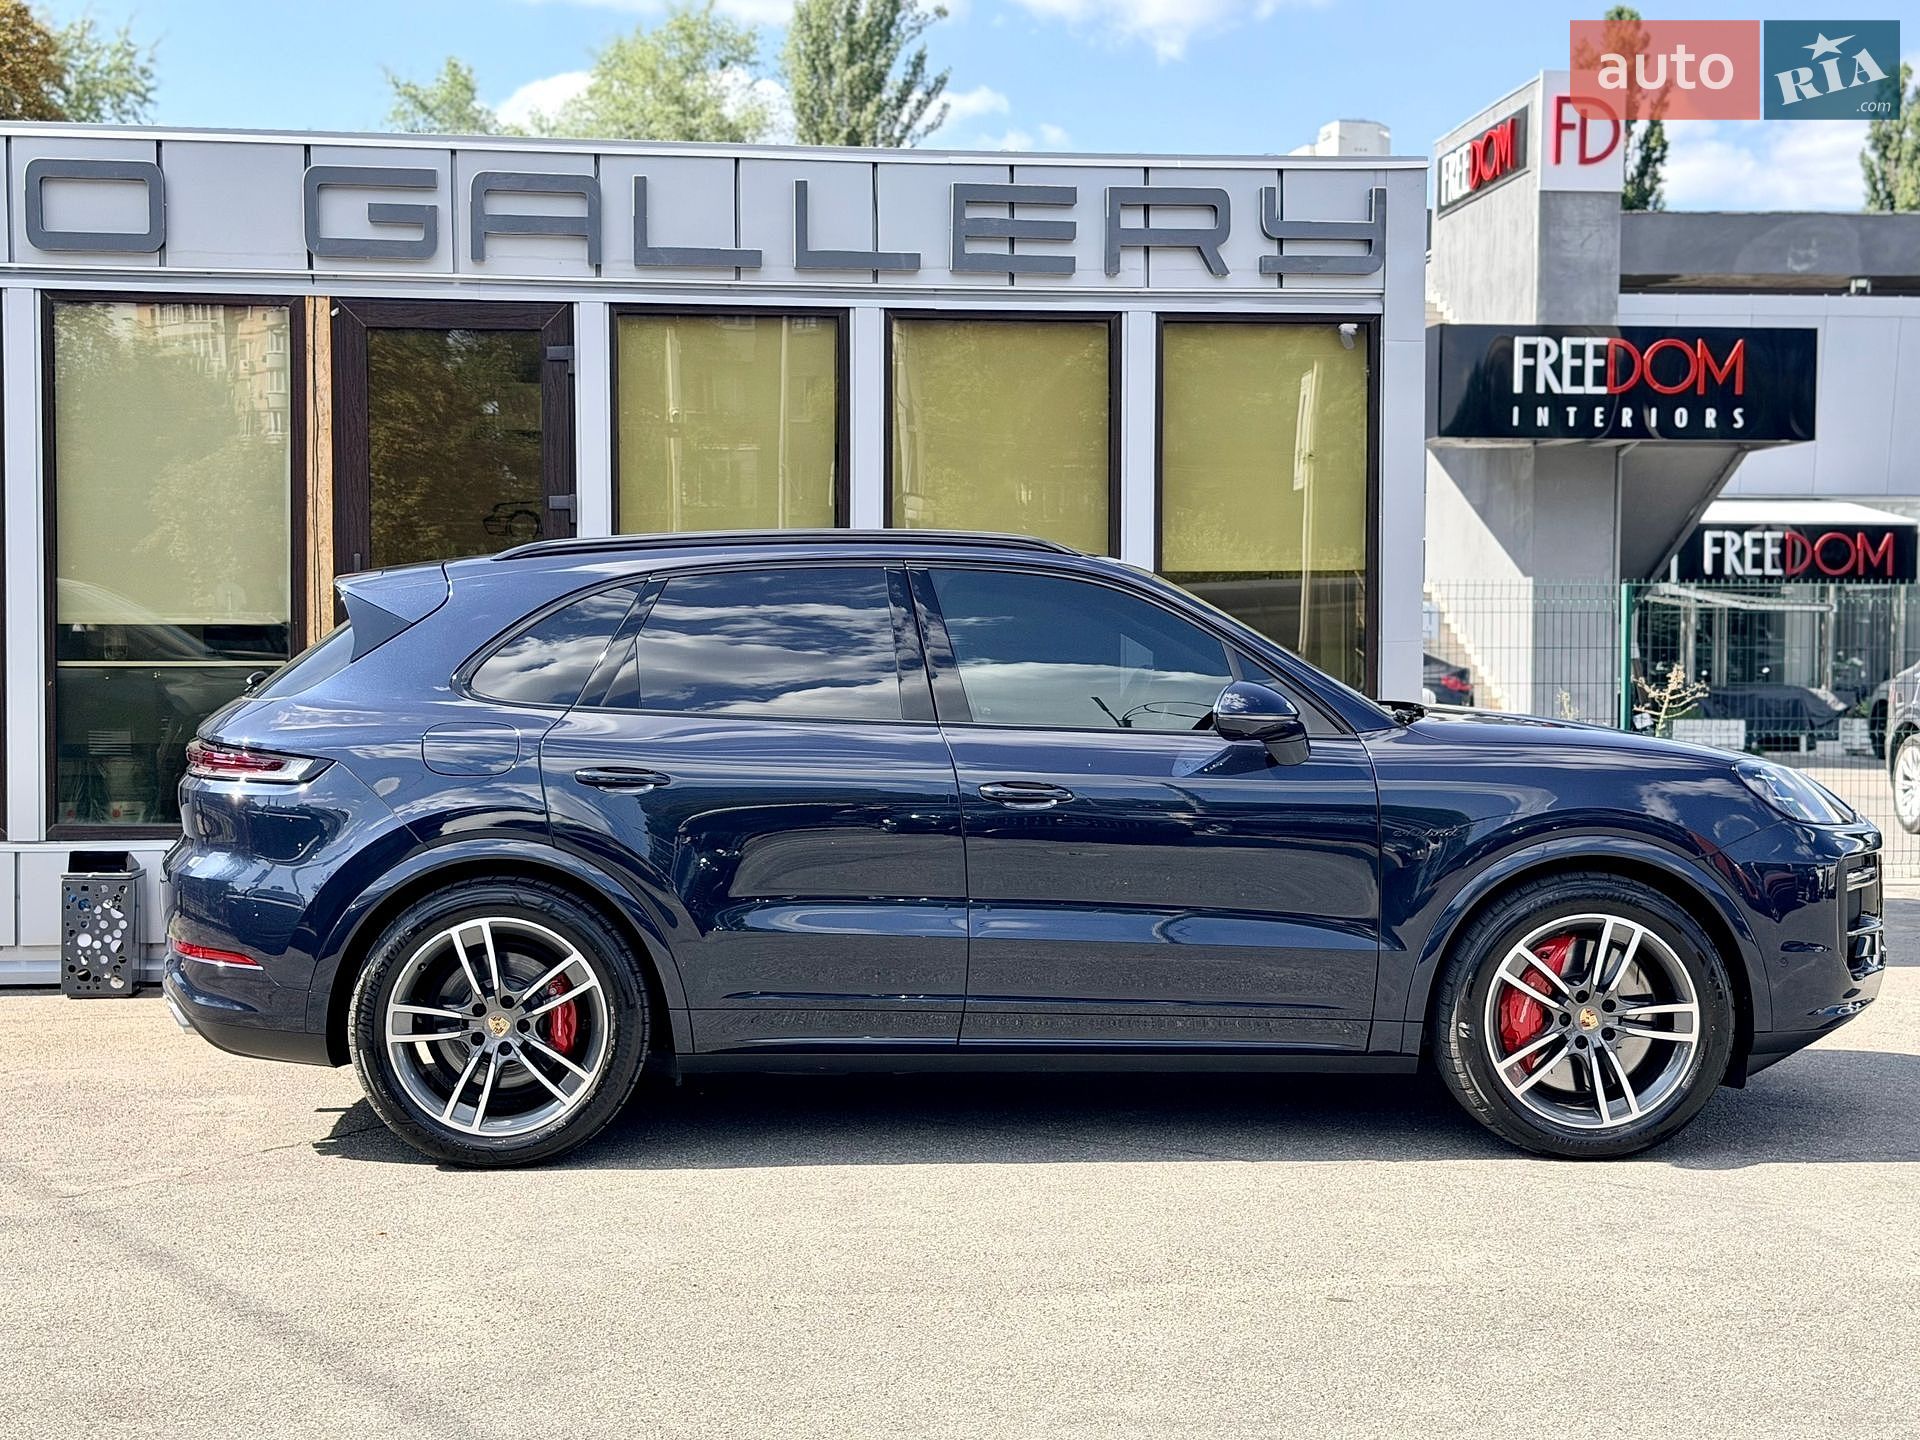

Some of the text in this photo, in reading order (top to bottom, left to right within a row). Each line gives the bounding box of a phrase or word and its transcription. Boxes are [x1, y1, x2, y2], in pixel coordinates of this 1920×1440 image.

[1440, 117, 1515, 206] FREEDOM
[1552, 96, 1621, 166] FD
[304, 164, 1387, 279] GALLERY
[1512, 336, 1746, 395] FREEDOM
[1512, 406, 1745, 429] INTERIORS
[1703, 530, 1895, 577] FREEDOM
